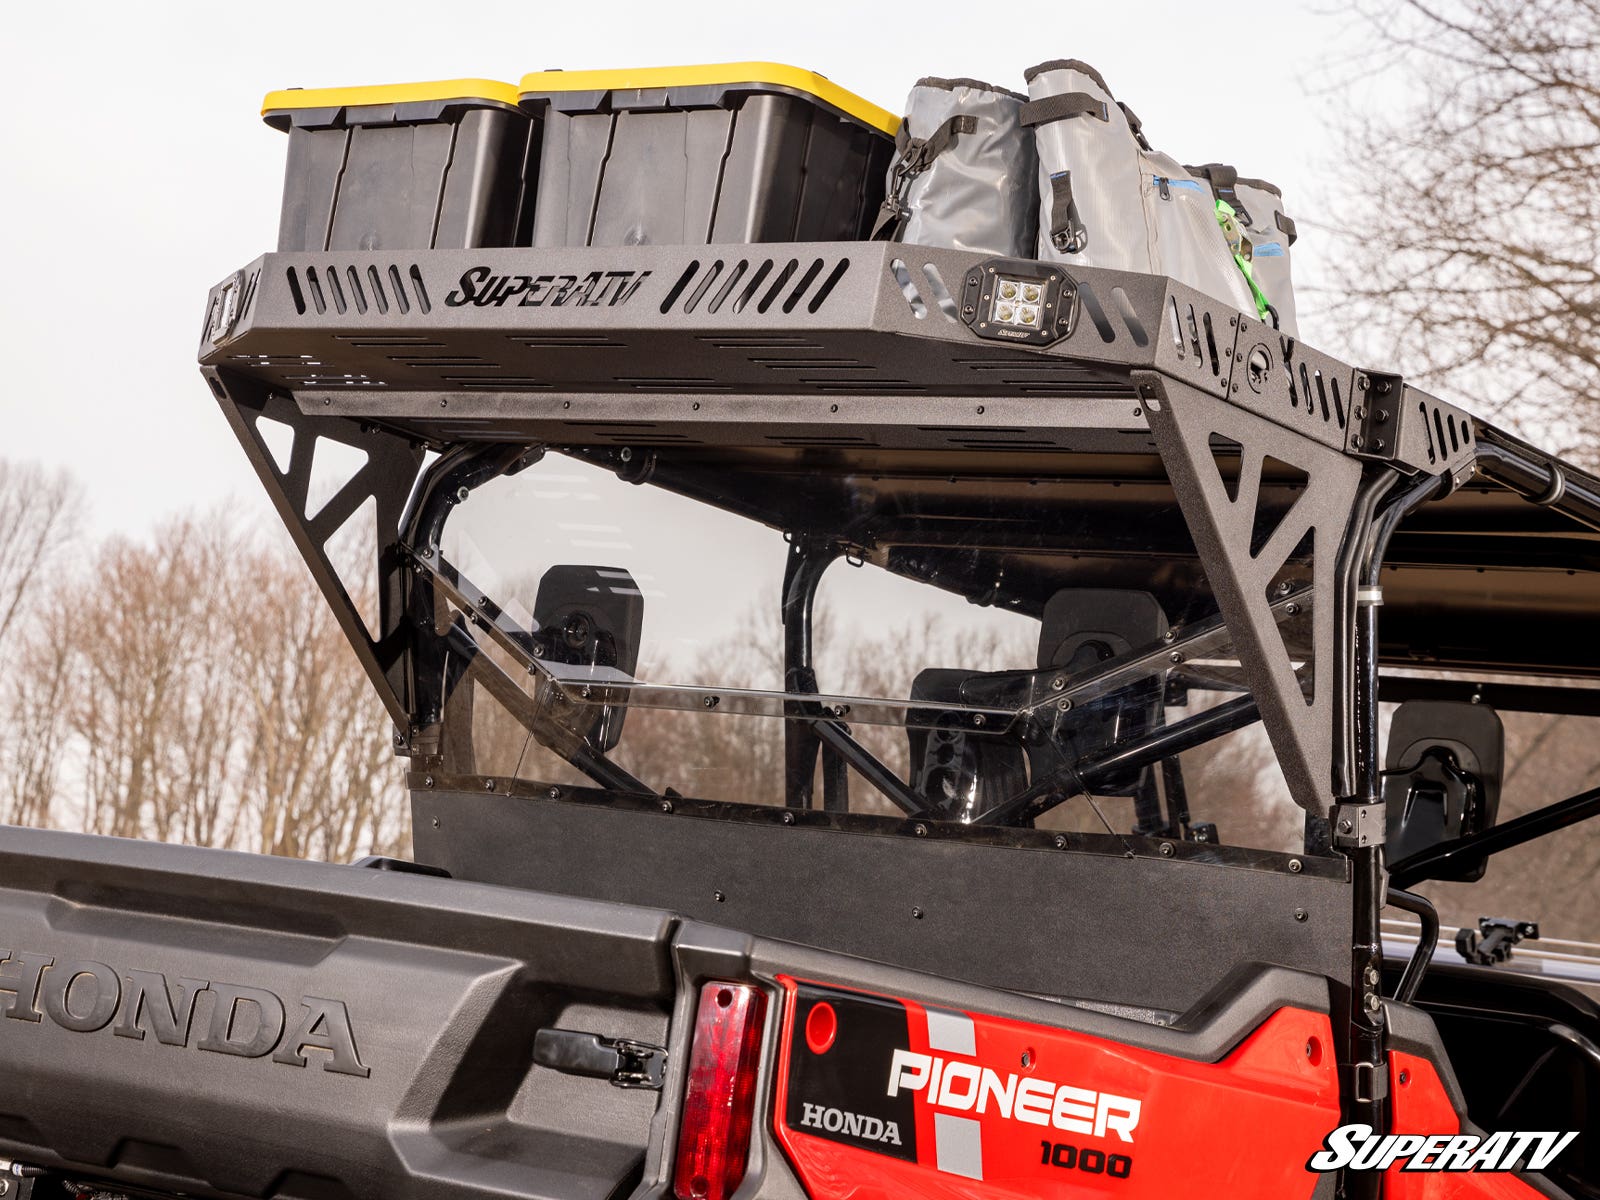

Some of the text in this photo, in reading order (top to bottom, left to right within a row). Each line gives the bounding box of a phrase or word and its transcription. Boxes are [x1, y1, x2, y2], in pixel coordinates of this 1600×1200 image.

[445, 266, 653, 307] SUPERATV
[0, 951, 371, 1078] HONDA
[887, 1048, 1142, 1143] PIONEER
[800, 1102, 902, 1146] HONDA
[1040, 1140, 1133, 1179] 1000
